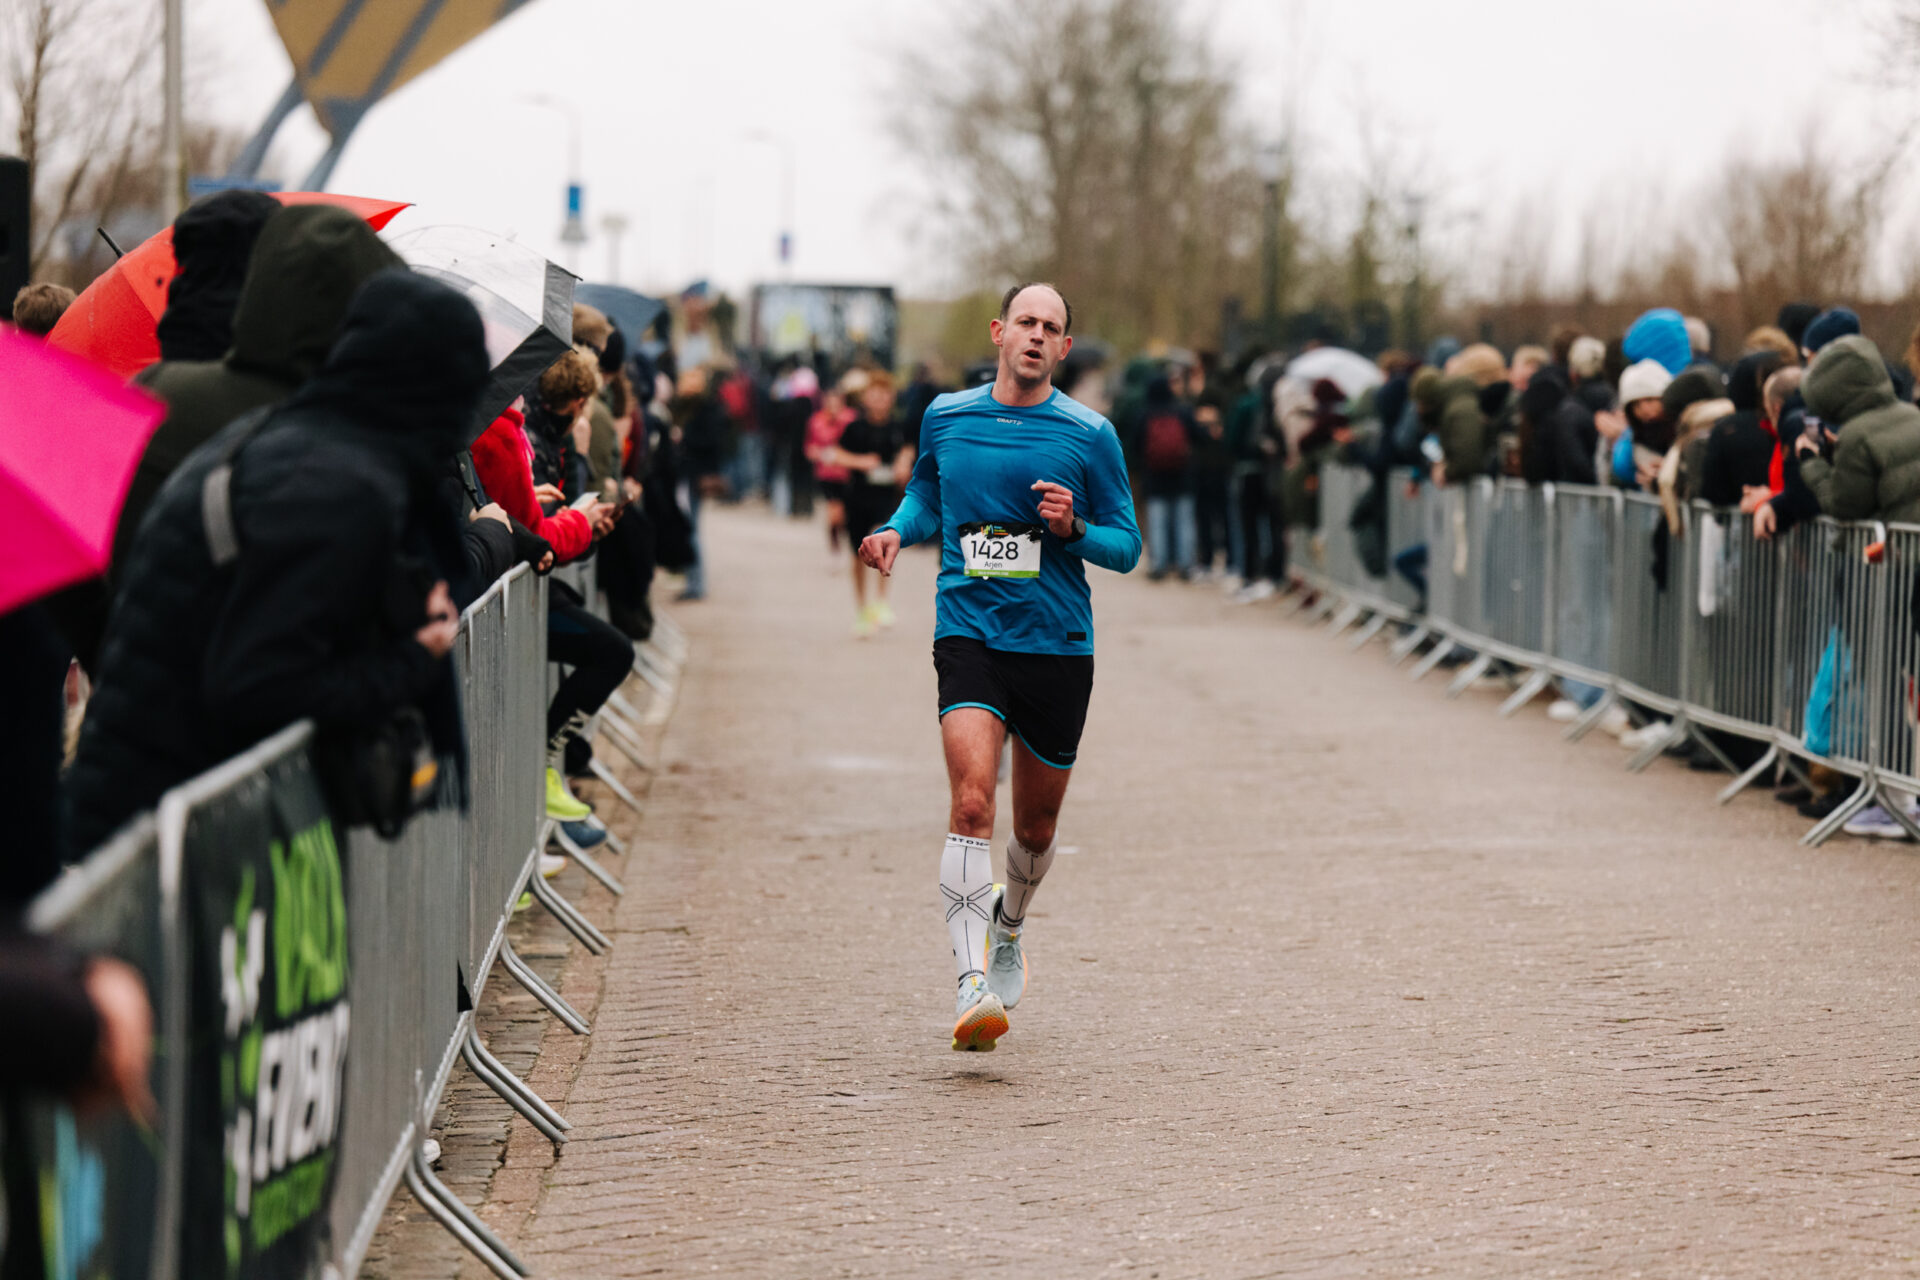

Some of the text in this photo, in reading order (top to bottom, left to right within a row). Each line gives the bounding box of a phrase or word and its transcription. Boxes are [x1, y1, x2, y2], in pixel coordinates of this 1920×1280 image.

[996, 417, 1018, 425] CRAFT
[970, 540, 1019, 560] 1428
[984, 561, 1003, 569] Arjen
